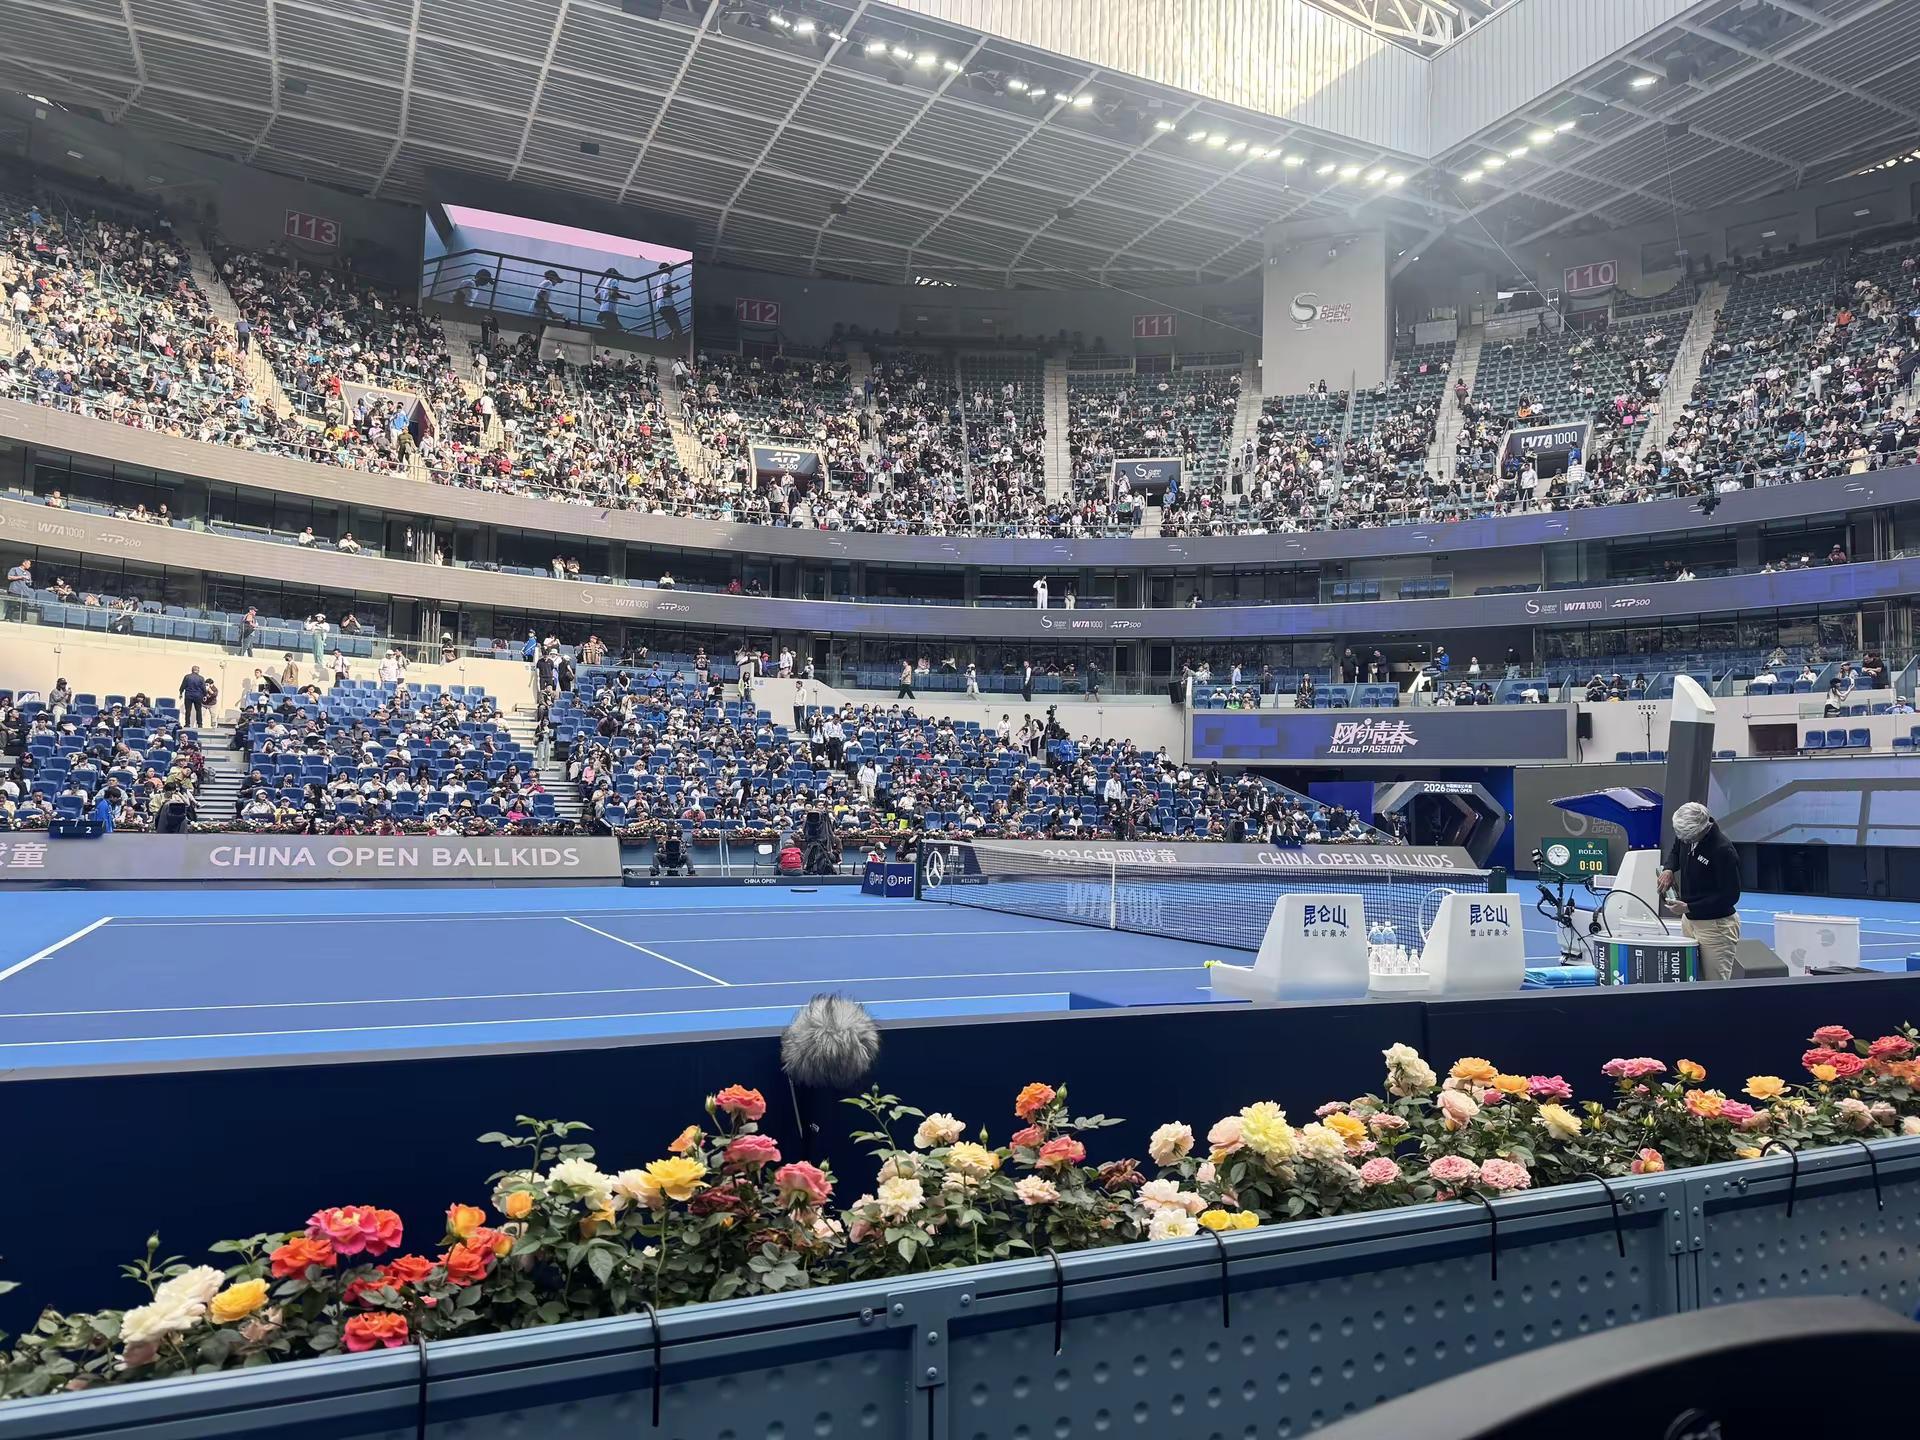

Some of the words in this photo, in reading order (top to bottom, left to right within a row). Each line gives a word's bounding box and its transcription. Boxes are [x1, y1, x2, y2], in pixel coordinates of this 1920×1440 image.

[288, 213, 337, 244] 113
[1567, 263, 1614, 290] 110
[738, 300, 777, 322] 112
[1321, 303, 1352, 313] CHINA
[1320, 311, 1348, 320] OPEN
[1138, 316, 1173, 336] 111
[1553, 431, 1578, 445] 1000
[767, 451, 801, 464] ATP
[1327, 745, 1347, 754] ALL
[1361, 745, 1407, 754] PASSION
[1423, 783, 1446, 793] 2026
[85, 826, 92, 834] 2
[1592, 825, 1618, 834] OPEN
[209, 846, 316, 867] CHINA
[327, 846, 419, 867] OPEN
[432, 847, 580, 867] BALLKIDS
[1257, 852, 1315, 865] CHINA
[1317, 852, 1368, 866] OPEN
[1371, 853, 1455, 868] BALLKIDS
[1697, 854, 1710, 866] WTA
[1579, 860, 1603, 871] 0:00
[874, 874, 884, 884] PIF
[898, 876, 913, 885] PIF
[1303, 904, 1346, 928] 昆仑山
[1470, 904, 1508, 926] 昆仑山
[1303, 928, 1348, 938] 雪山矿泉水
[1470, 928, 1509, 937] 雪山矿泉水
[1598, 946, 1606, 970] TOUR
[1671, 950, 1680, 976] TOUR
